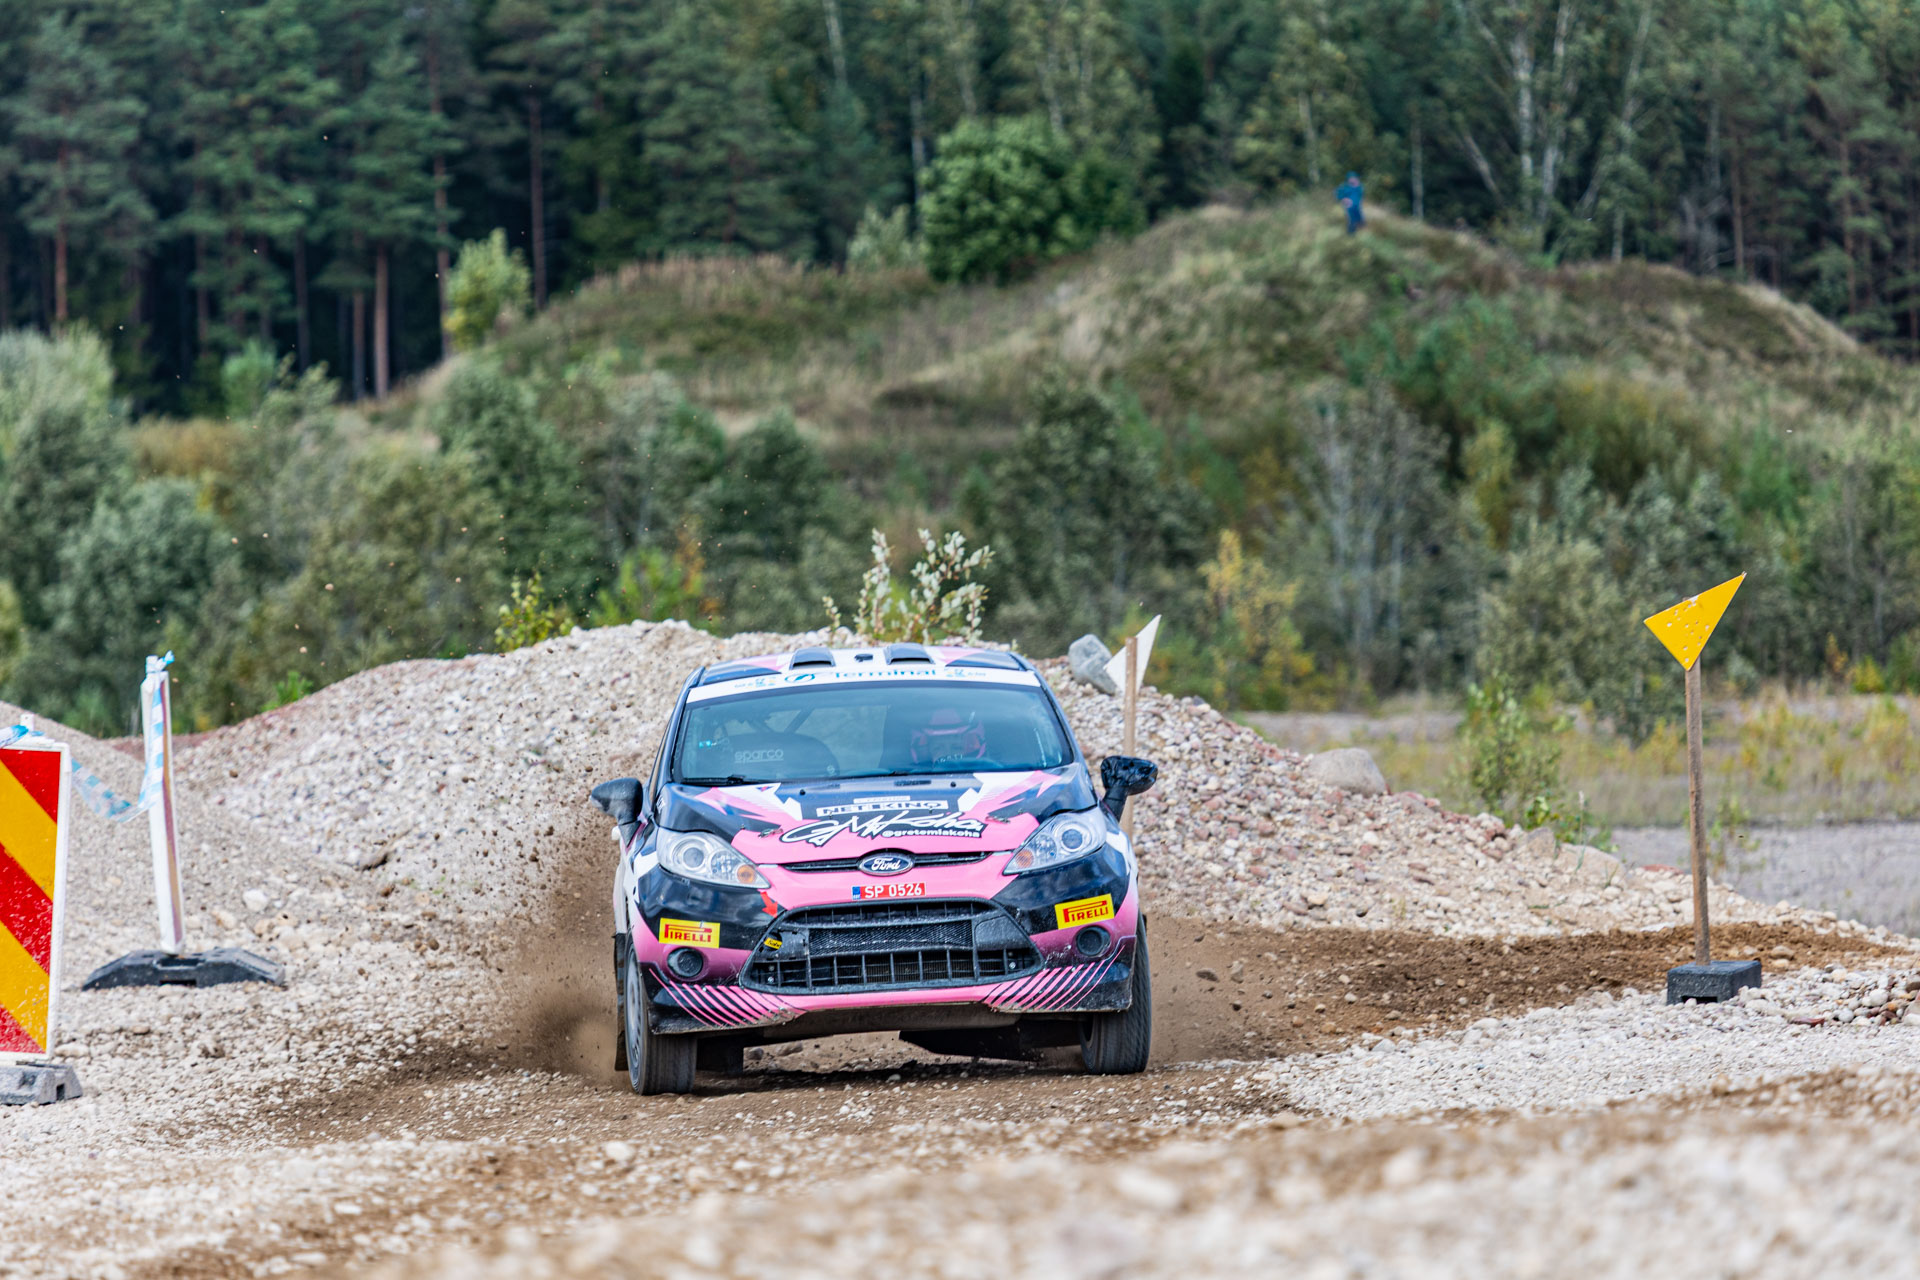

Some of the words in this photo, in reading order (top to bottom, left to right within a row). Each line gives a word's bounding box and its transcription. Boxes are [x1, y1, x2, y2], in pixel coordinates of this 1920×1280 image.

[734, 748, 784, 764] sparco
[871, 857, 901, 871] Ford
[864, 885, 885, 899] SP
[888, 882, 923, 898] 0526
[1062, 900, 1109, 923] PIRELLI
[663, 923, 713, 943] PIRELLI
